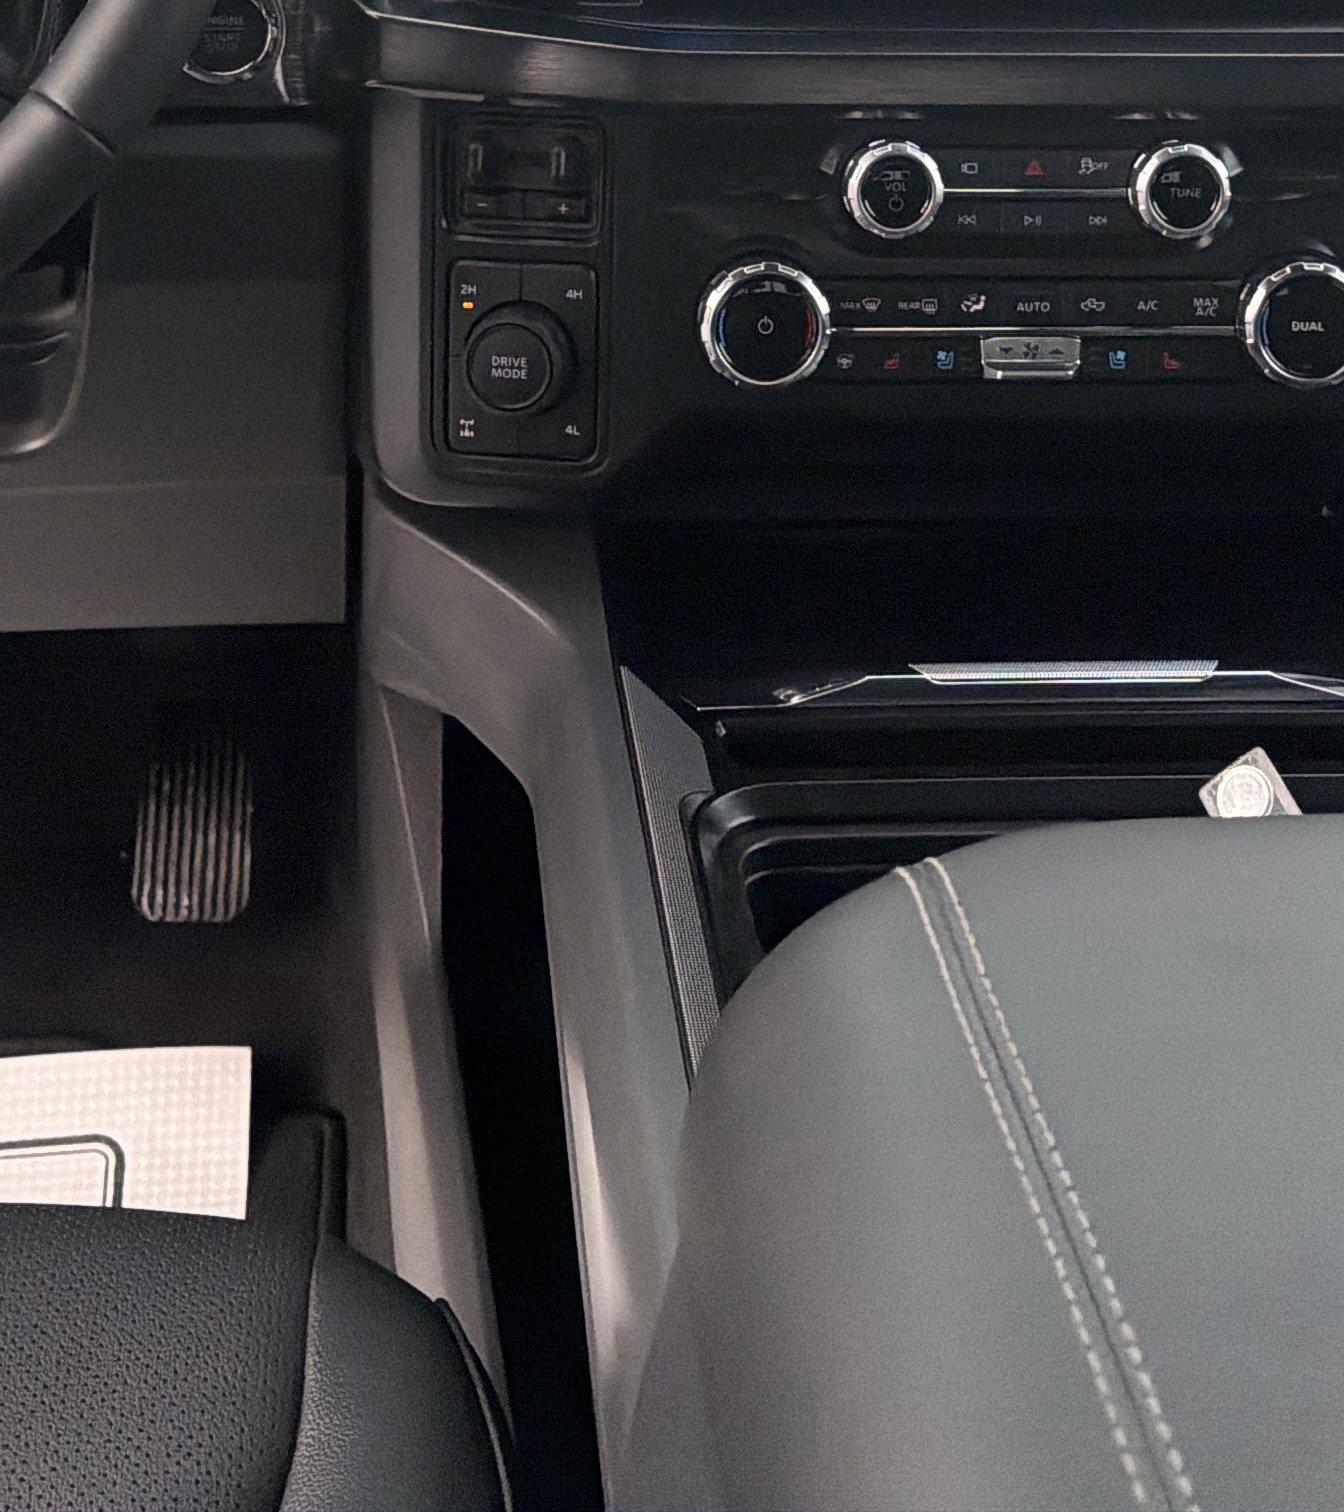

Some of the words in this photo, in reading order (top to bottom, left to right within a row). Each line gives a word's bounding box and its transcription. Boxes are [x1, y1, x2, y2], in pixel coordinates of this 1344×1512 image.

[885, 182, 908, 192] VOL
[1170, 187, 1202, 199] TUNE
[460, 283, 477, 295] 2H
[565, 289, 583, 300] 4H
[1016, 301, 1051, 313] AUTO
[1137, 299, 1158, 312] A/C
[1193, 297, 1219, 307] MAX
[1196, 307, 1217, 317] A/C
[1291, 320, 1325, 332] DUAL
[491, 355, 527, 368] DRIVE
[490, 368, 527, 380] MODE
[564, 424, 581, 436] 4L
